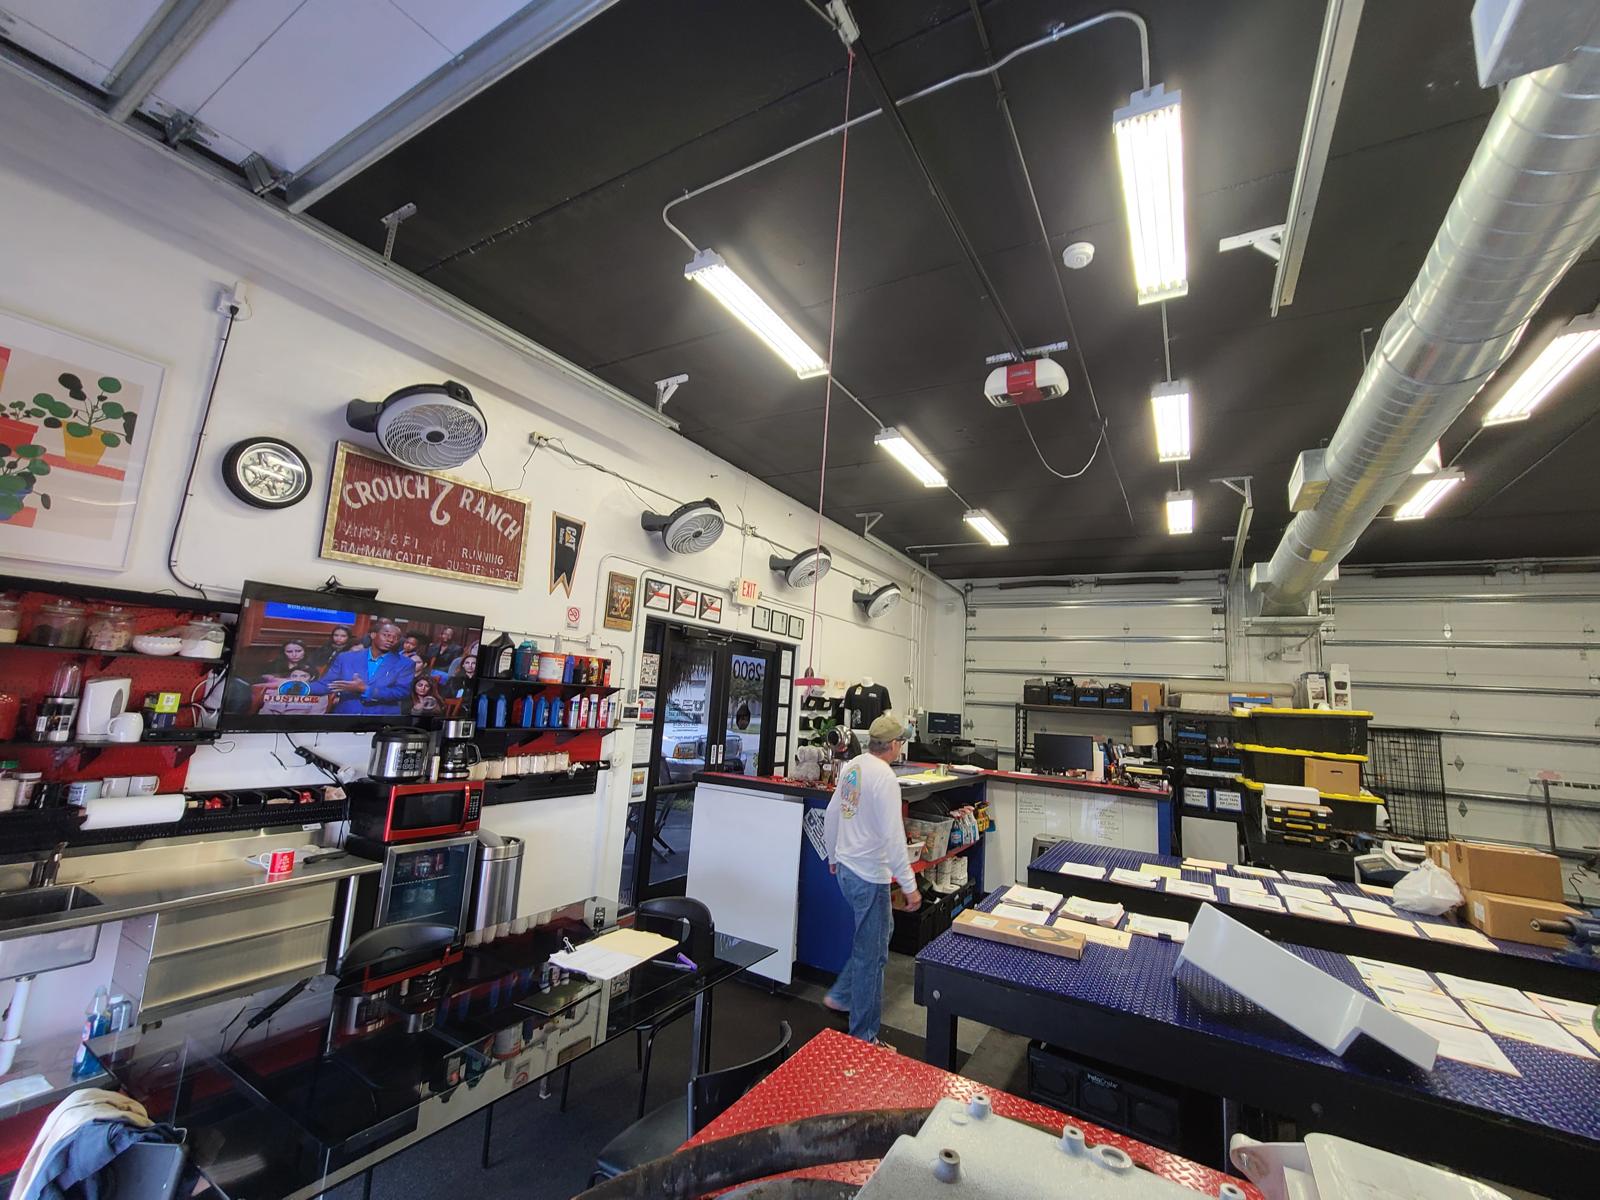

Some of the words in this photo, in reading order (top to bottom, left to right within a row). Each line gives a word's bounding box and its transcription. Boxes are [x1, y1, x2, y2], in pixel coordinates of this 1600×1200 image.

[342, 474, 430, 509] CROUCH
[459, 488, 521, 541] RANCH
[565, 526, 577, 552] CAT
[396, 551, 432, 567] CATTLE
[461, 547, 504, 565] RUNNING
[741, 580, 757, 600] EXIT
[263, 694, 319, 705] JUSTICE
